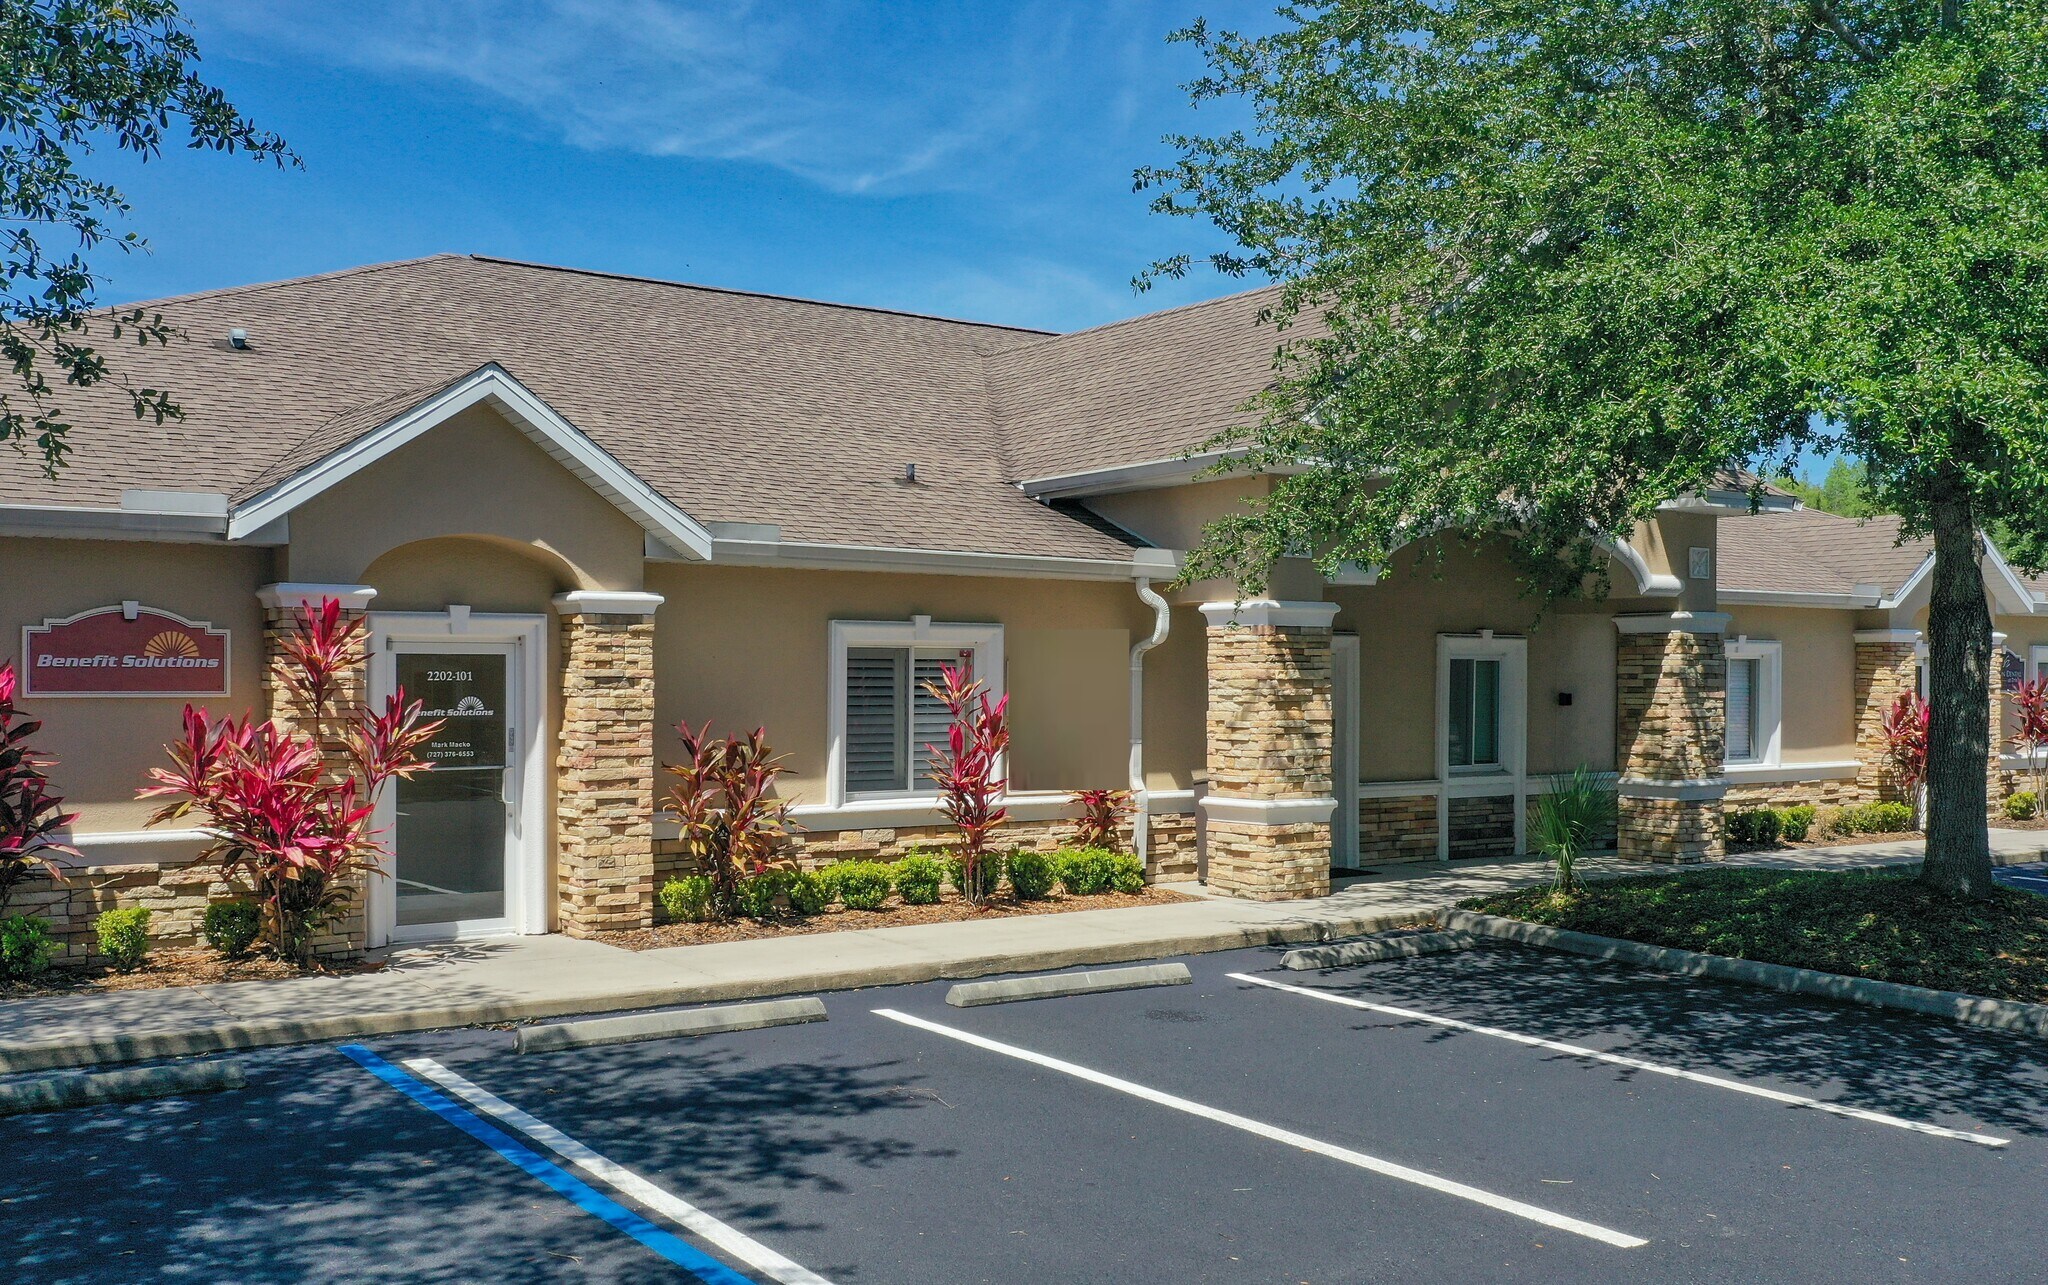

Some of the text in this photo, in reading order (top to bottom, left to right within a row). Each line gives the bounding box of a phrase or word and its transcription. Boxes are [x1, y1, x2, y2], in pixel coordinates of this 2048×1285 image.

[37, 654, 219, 668] Benefit Solutions
[427, 671, 473, 681] 2202-101
[417, 709, 446, 717] enefit
[426, 751, 443, 759] (727)
